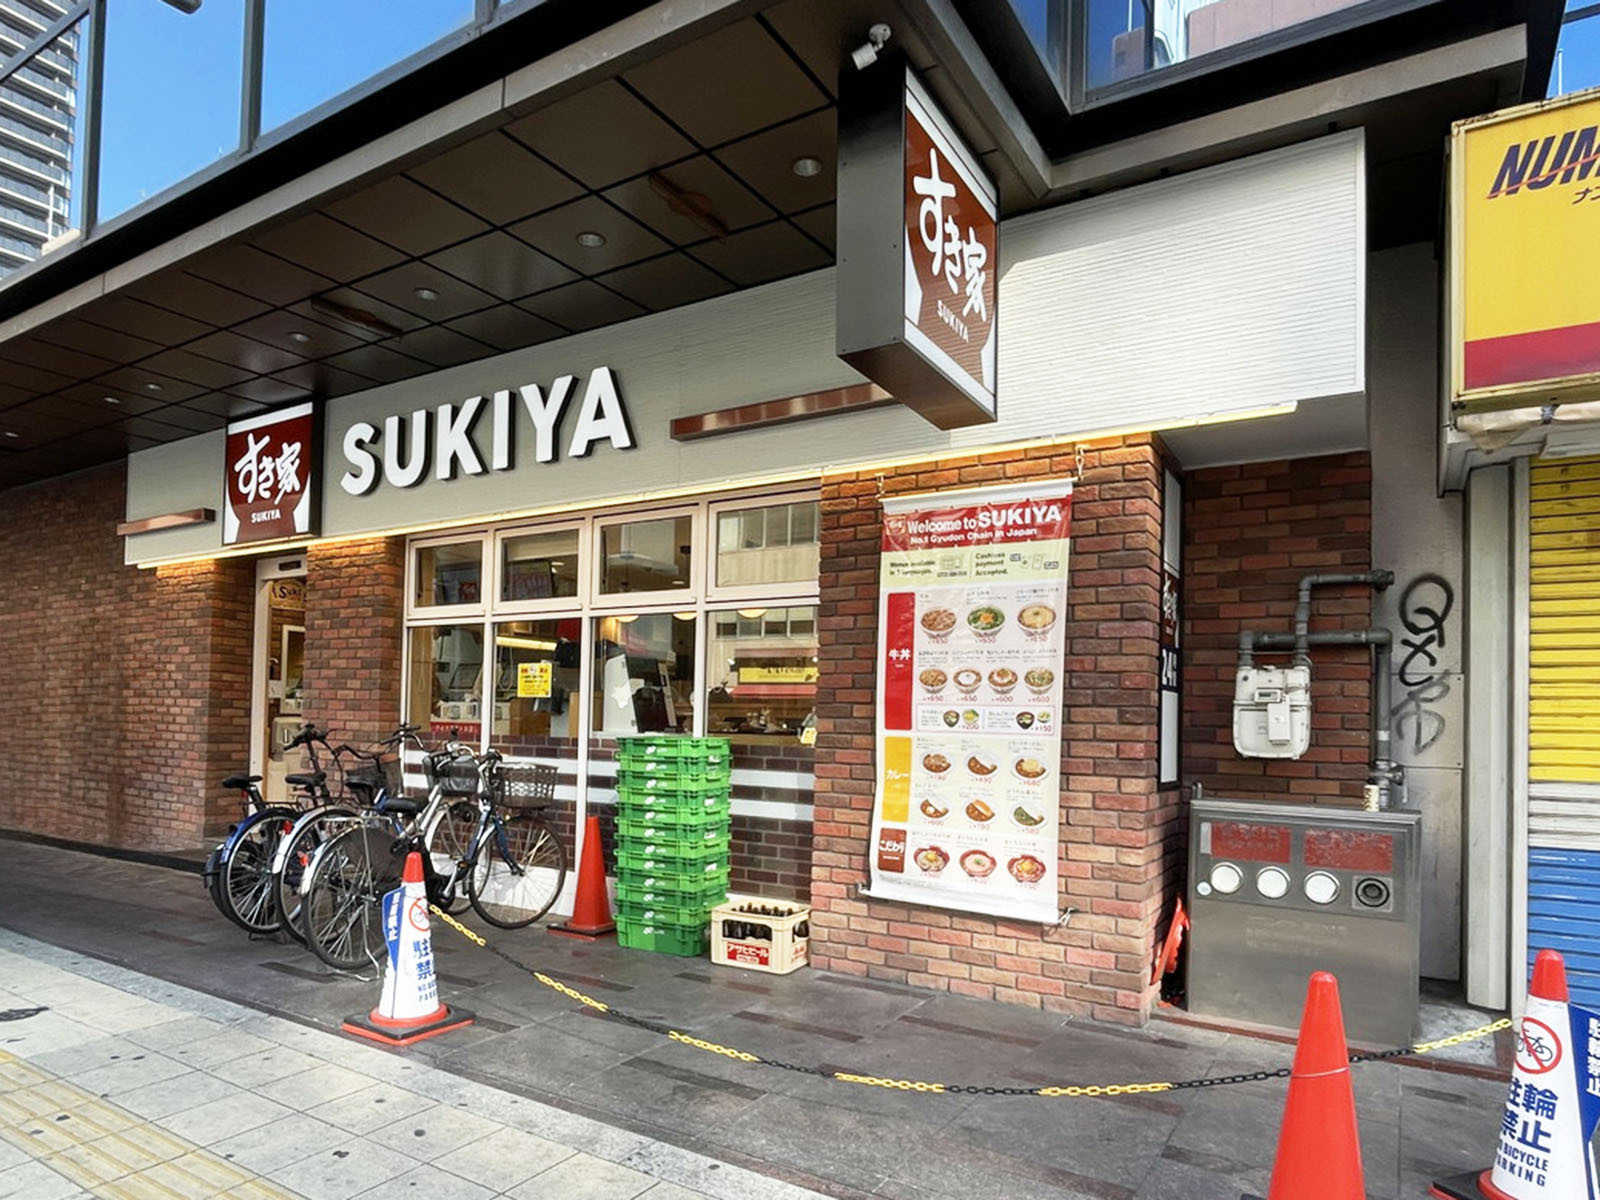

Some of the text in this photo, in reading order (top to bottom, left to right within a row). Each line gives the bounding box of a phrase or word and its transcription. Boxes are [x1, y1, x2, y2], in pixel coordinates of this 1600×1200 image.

[913, 147, 987, 322] すき家
[937, 300, 969, 342] SUKIYA
[340, 366, 632, 496] SUKIYA
[234, 432, 301, 505] すき家
[251, 509, 281, 523] SUKIYA
[907, 519, 962, 534] Welcome
[963, 516, 977, 530] to
[978, 505, 1062, 528] SUKIYA
[930, 533, 965, 544] Gyudon
[966, 530, 993, 541] Chain
[1006, 527, 1038, 537] Japan
[727, 943, 769, 957] アサヒビール
[1503, 1142, 1550, 1172] BICYCLE
